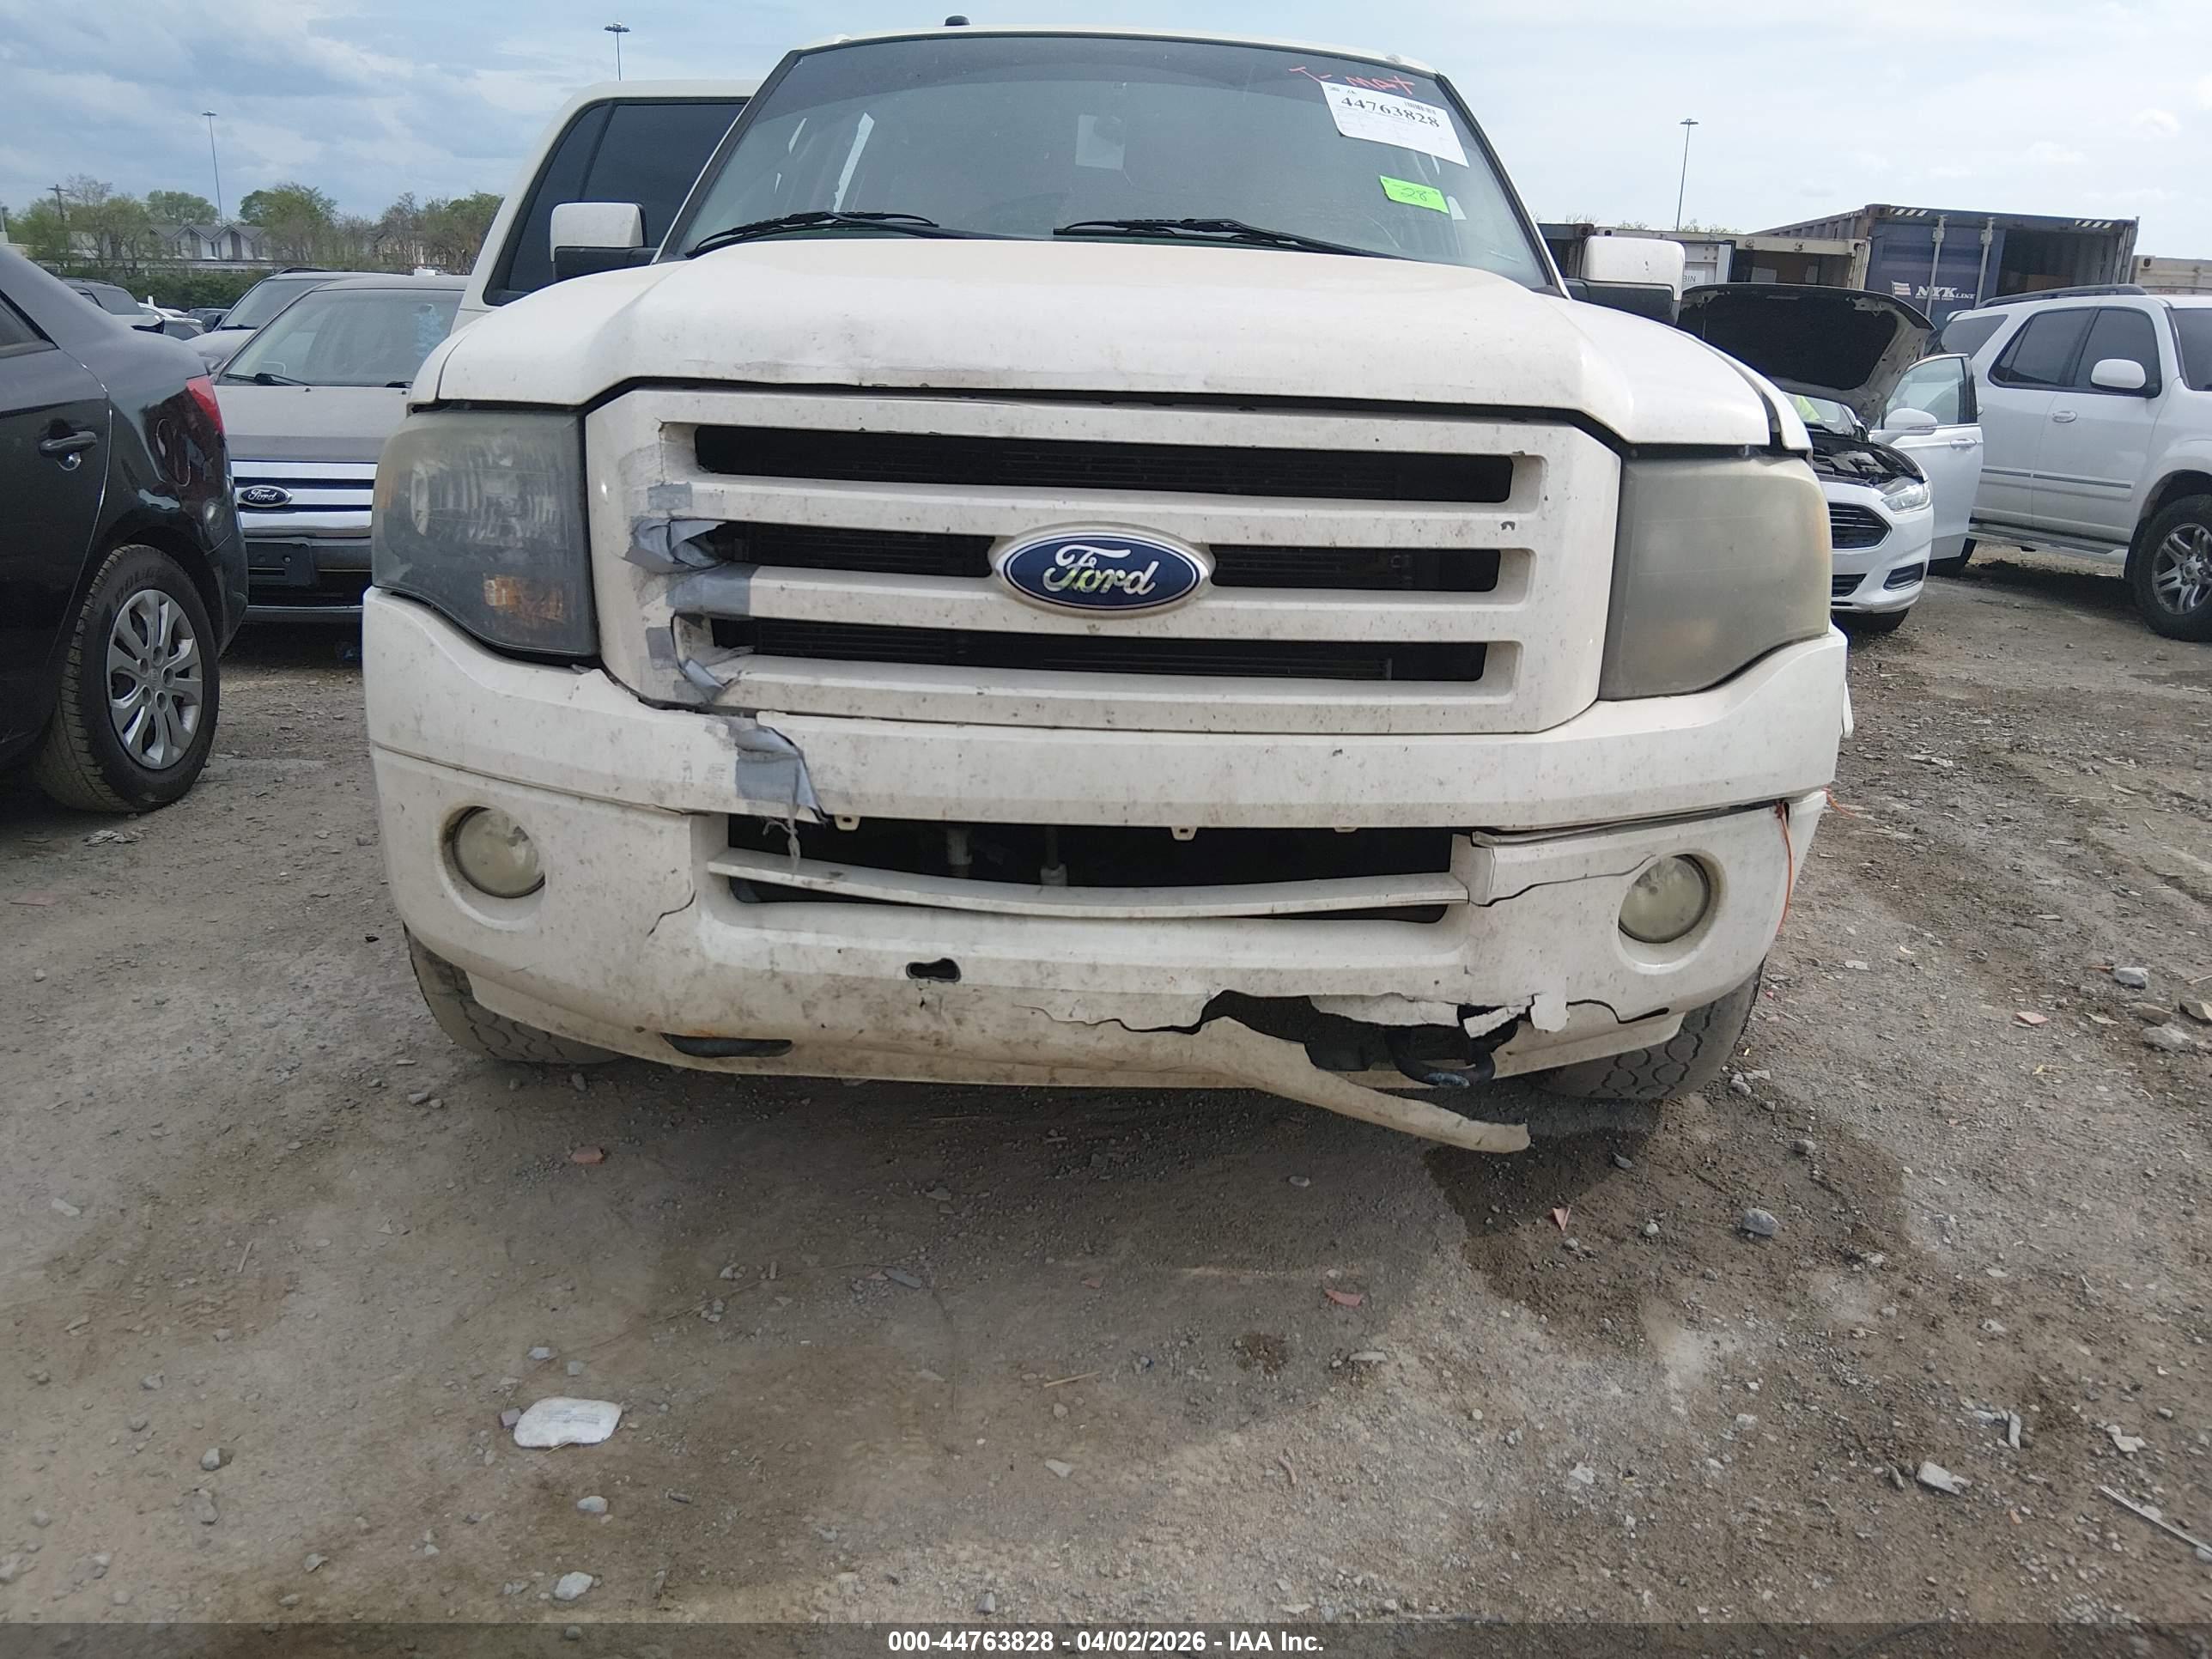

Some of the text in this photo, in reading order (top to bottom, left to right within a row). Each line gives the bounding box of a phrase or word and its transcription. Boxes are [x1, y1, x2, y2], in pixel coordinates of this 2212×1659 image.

[1341, 96, 1440, 128] 44763828
[1915, 285, 1958, 299] NYK
[247, 488, 277, 501] Ford
[1042, 544, 1159, 596] Ford
